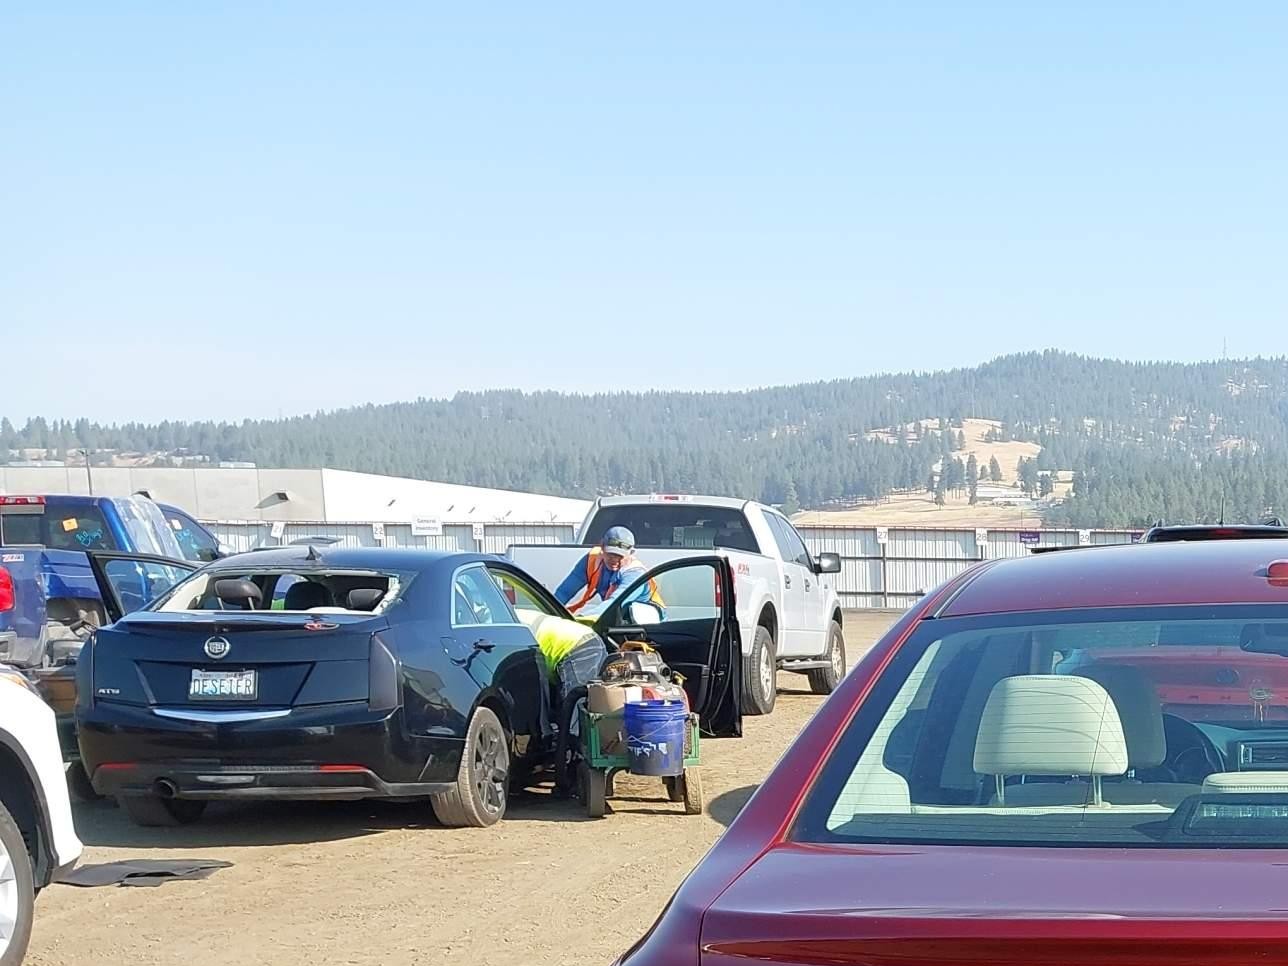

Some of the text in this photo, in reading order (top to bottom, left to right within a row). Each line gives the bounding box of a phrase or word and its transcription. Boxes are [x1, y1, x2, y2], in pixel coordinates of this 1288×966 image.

[374, 527, 384, 535] 22
[473, 527, 482, 535] 23
[878, 530, 888, 539] 27
[976, 533, 987, 541] 28
[1079, 534, 1090, 542] 29
